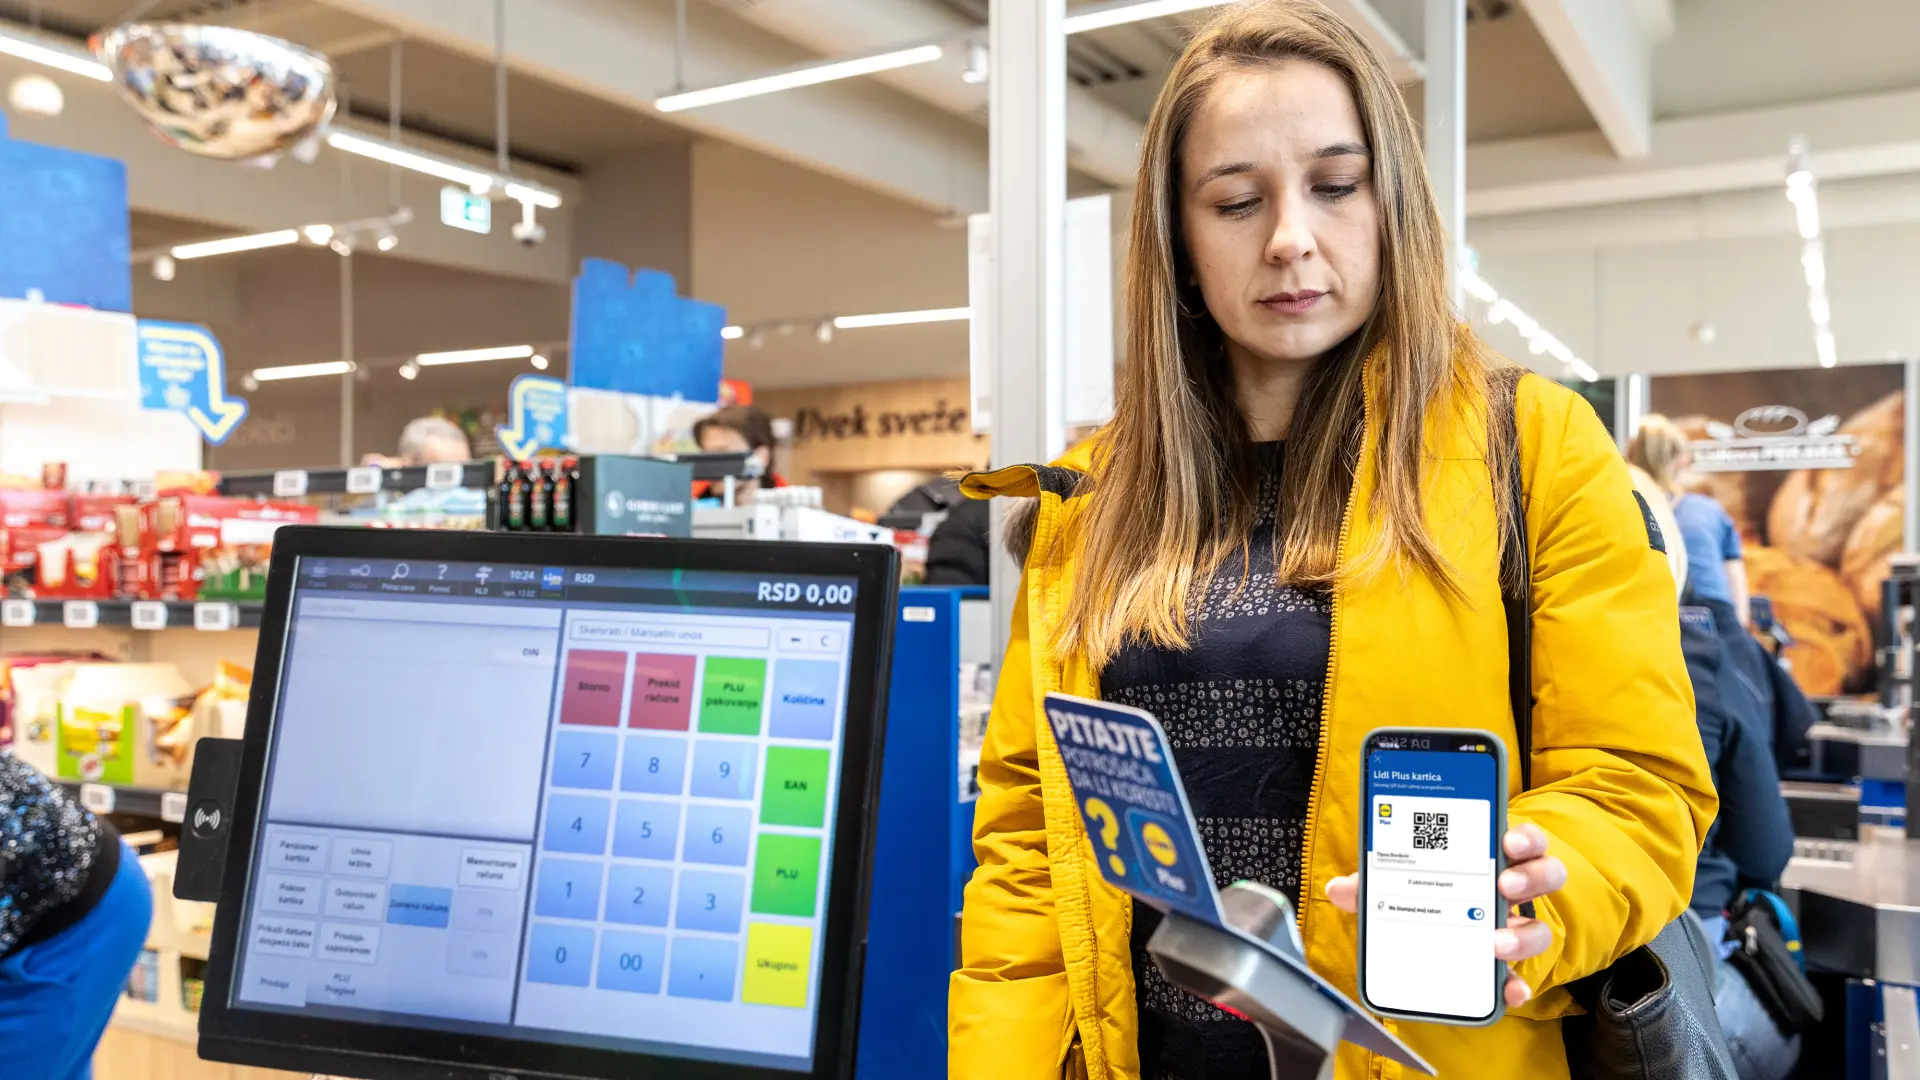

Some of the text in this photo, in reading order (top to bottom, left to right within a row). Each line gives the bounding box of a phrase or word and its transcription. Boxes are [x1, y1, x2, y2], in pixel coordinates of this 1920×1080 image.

[510, 570, 535, 580] 10:24
[574, 573, 595, 584] RSD
[758, 582, 852, 607] RSD 0,00
[631, 627, 676, 640] Manuelni
[678, 630, 703, 641] unos
[522, 648, 540, 657] DIN
[578, 681, 611, 693] Storno
[647, 677, 680, 690] Prekid
[722, 682, 744, 693] PLU
[645, 691, 680, 704] računa
[705, 696, 759, 710] pakovanje
[782, 693, 825, 706] Količina
[1048, 708, 1163, 763] PITAJTE
[580, 752, 591, 769] 7
[648, 757, 659, 773] 8
[719, 762, 730, 778] 9
[1373, 770, 1442, 782] Lidl Plus kartica
[784, 780, 808, 791] EAN
[1069, 767, 1092, 791] DA
[571, 817, 582, 832] 4
[640, 822, 652, 839] 5
[711, 827, 723, 844] 6
[284, 853, 310, 863] kartica
[776, 868, 798, 880] PLU
[565, 881, 573, 898] 1
[633, 887, 644, 905] 2
[704, 893, 716, 911] 3
[555, 947, 567, 964] 0
[620, 953, 643, 972] 00
[757, 958, 798, 972] Ukupno
